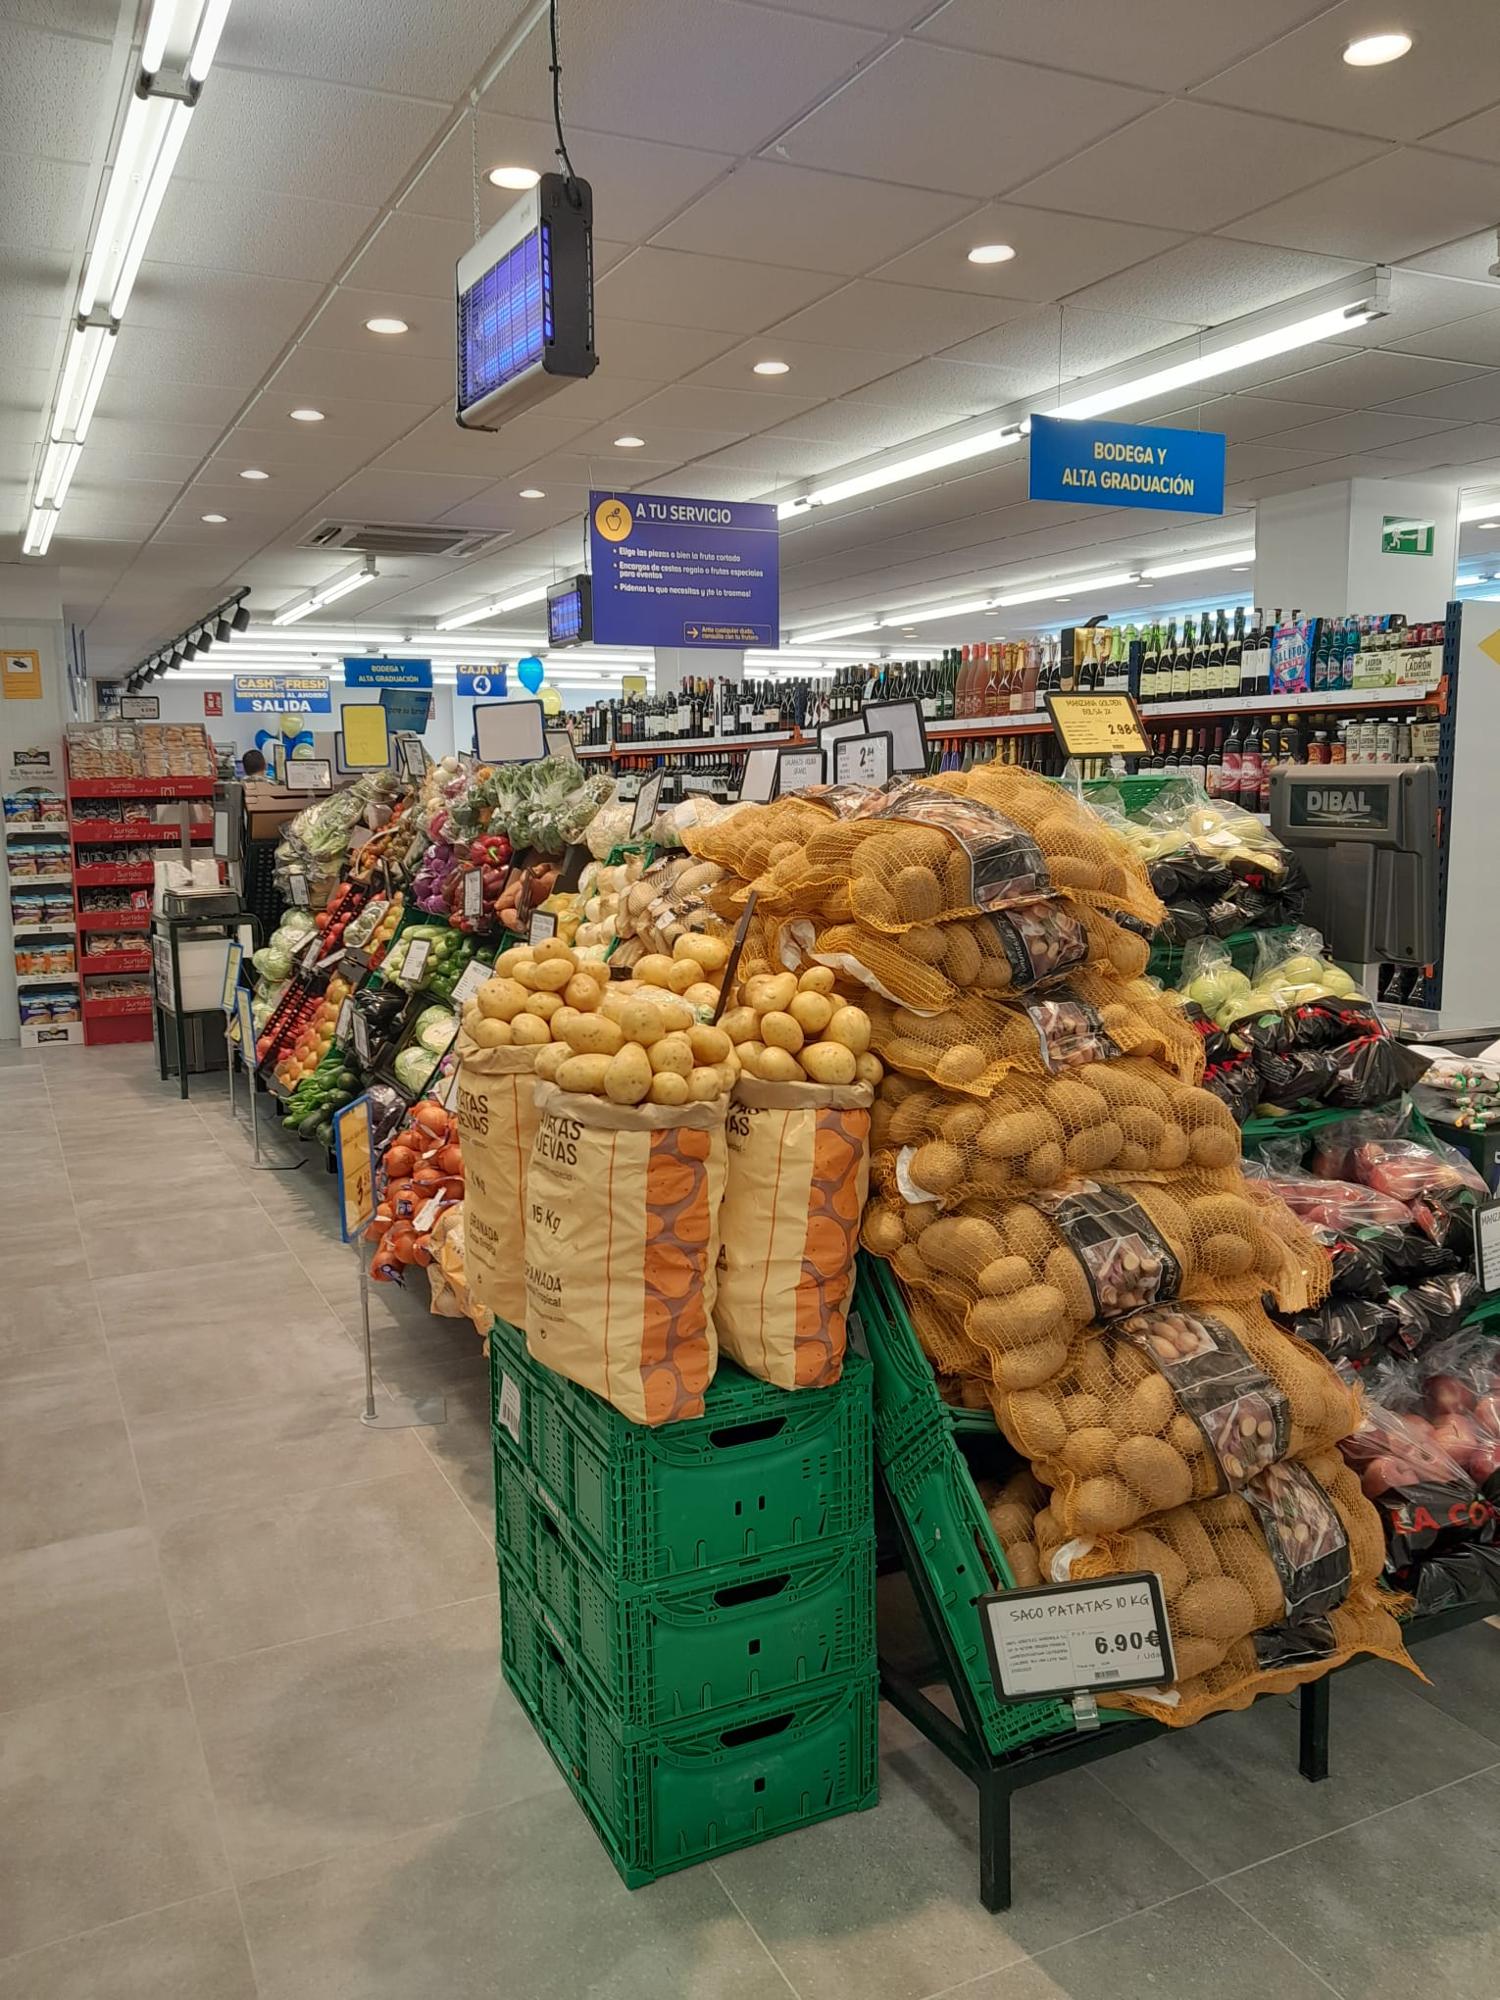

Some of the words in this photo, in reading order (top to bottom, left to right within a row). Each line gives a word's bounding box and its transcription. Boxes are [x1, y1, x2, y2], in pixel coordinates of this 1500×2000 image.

[1093, 442, 1154, 465] BODEGA
[1157, 448, 1168, 465] Y
[1061, 467, 1097, 488] ALTA
[1100, 473, 1195, 496] GRADUACIÓN
[635, 502, 646, 518] A
[648, 503, 667, 520] TU
[669, 505, 732, 524] SERVICIO
[619, 546, 636, 557] Elige
[636, 547, 647, 557] las
[648, 549, 670, 559] piezas
[676, 551, 690, 560] bien
[691, 551, 698, 560] la
[699, 552, 716, 561] fruta
[716, 554, 741, 562] cortada
[619, 561, 650, 572] Encargos
[651, 563, 660, 571] de
[660, 565, 682, 573] cestas
[682, 565, 704, 575] regalo
[710, 566, 730, 576] frutas
[730, 569, 764, 578] especiales
[619, 570, 636, 579] para
[636, 571, 663, 580] eventos
[647, 584, 655, 593] lo
[655, 587, 669, 595] que
[669, 586, 700, 596] necesitas
[1273, 642, 1307, 664] SALITOS
[370, 665, 399, 673] BODEGA
[400, 665, 406, 673] Y
[459, 665, 488, 675] CAJA
[238, 678, 273, 689] CASH
[285, 679, 326, 689] FRESH
[358, 675, 375, 683] ALTA
[375, 675, 419, 683] GRADUACIÓN
[475, 677, 488, 692] 4
[252, 699, 312, 712] SALIDA
[1098, 699, 1123, 707] GOLDEN
[1306, 790, 1371, 812] DIBAL
[532, 1203, 543, 1224] 15
[544, 1208, 562, 1236] Kg
[1391, 1504, 1441, 1536] LA
[1009, 1606, 1044, 1623] SACO
[1047, 1598, 1113, 1618] PATATAS
[1116, 1596, 1127, 1609] 10
[1130, 1593, 1150, 1607] KG
[1095, 1629, 1161, 1655] 6.90€
